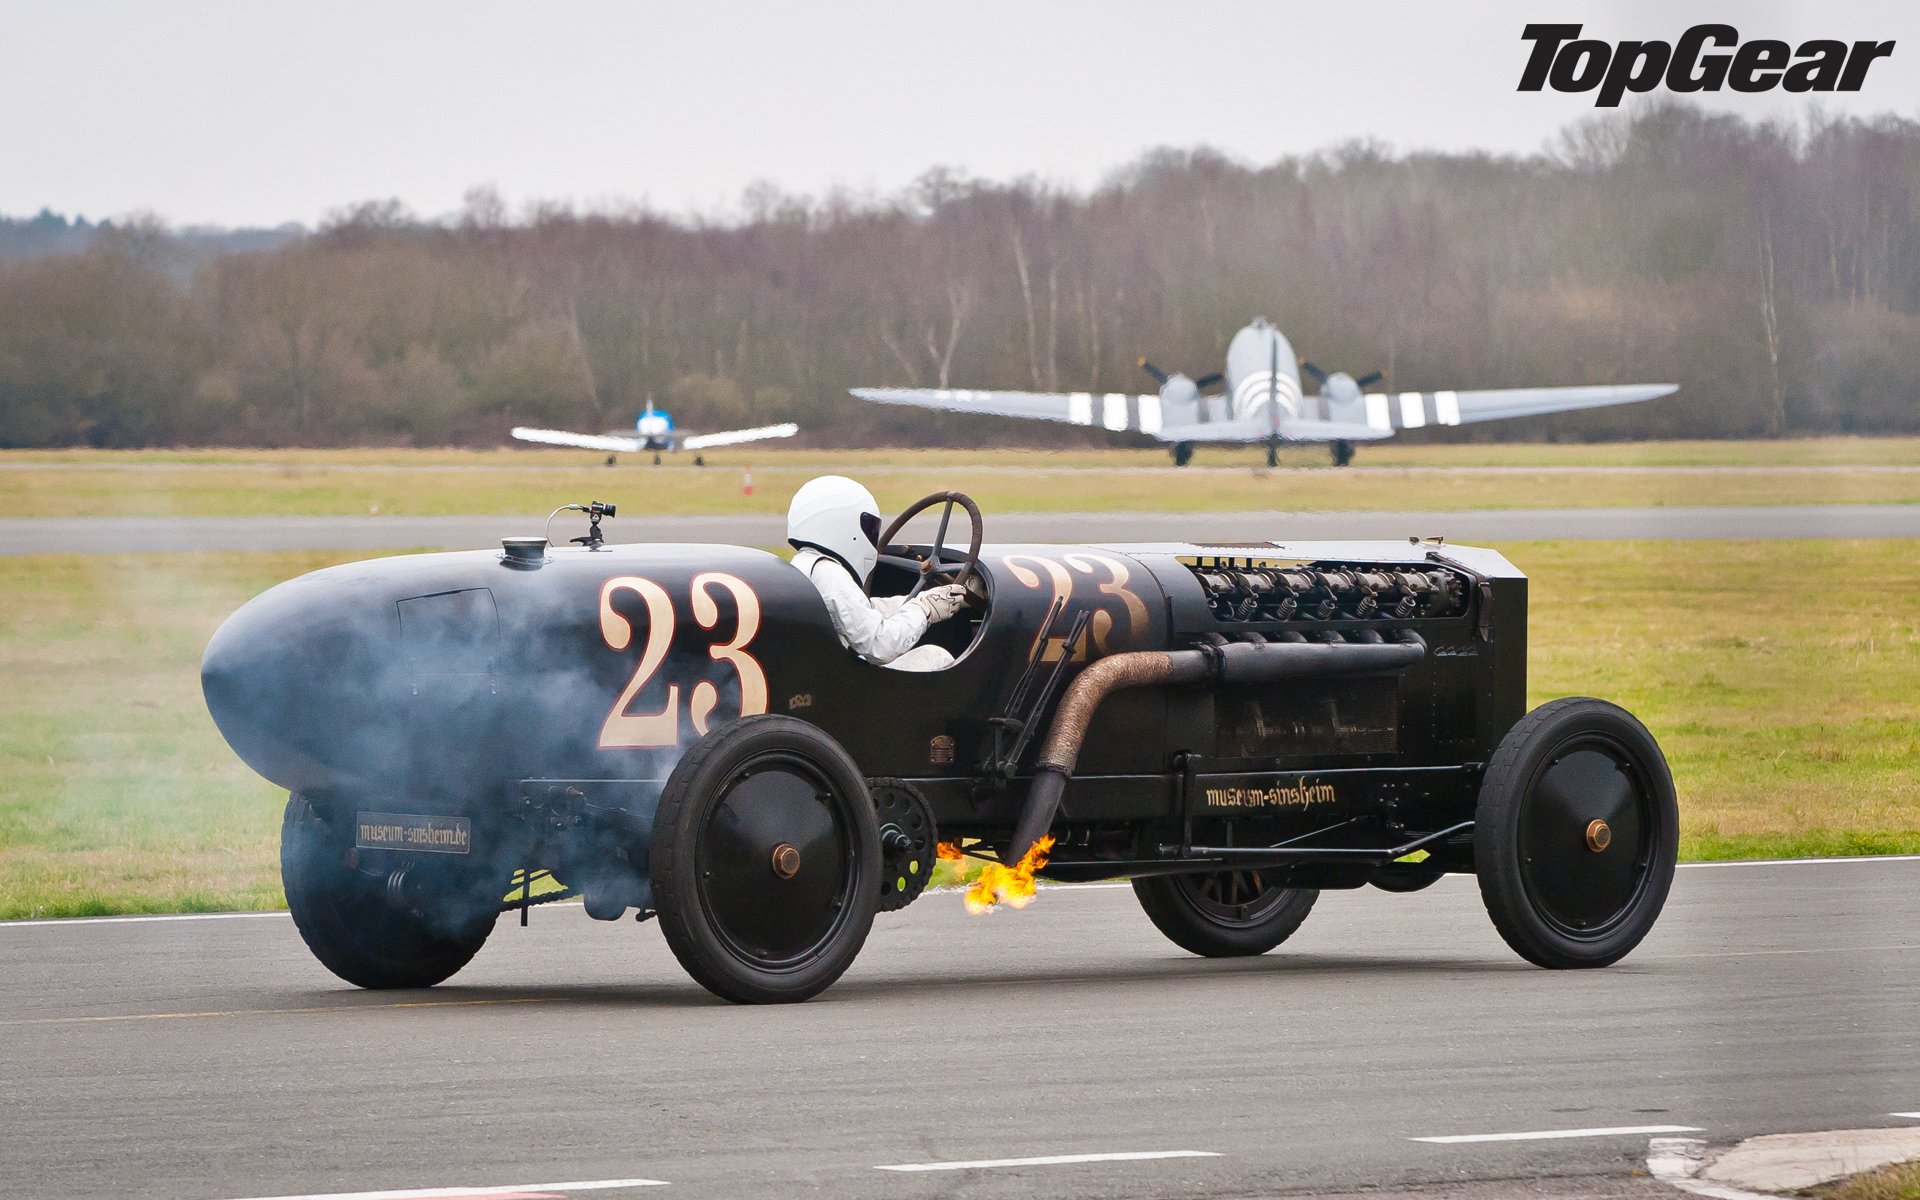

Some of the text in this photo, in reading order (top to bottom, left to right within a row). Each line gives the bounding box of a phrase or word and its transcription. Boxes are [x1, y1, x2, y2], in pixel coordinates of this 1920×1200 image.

[597, 571, 770, 749] 23
[1002, 553, 1150, 663] 23
[1206, 775, 1336, 812] museum-sinsheim
